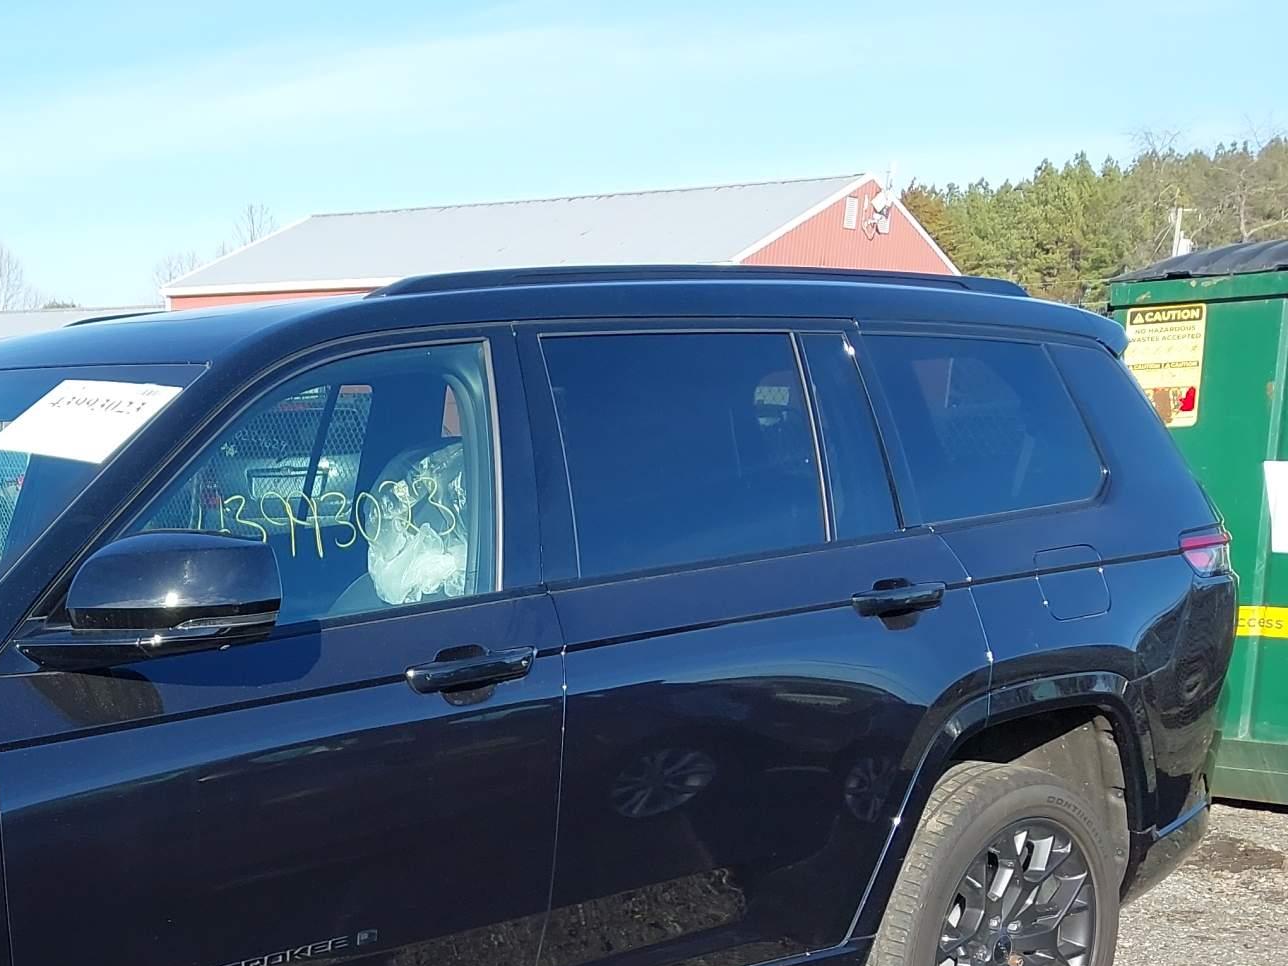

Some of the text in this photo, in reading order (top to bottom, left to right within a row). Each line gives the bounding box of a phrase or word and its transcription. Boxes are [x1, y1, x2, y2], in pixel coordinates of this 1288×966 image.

[1145, 308, 1200, 322] CAUTION
[1149, 325, 1196, 334] HAZARDOUS
[1162, 333, 1202, 342] ACCEPTED
